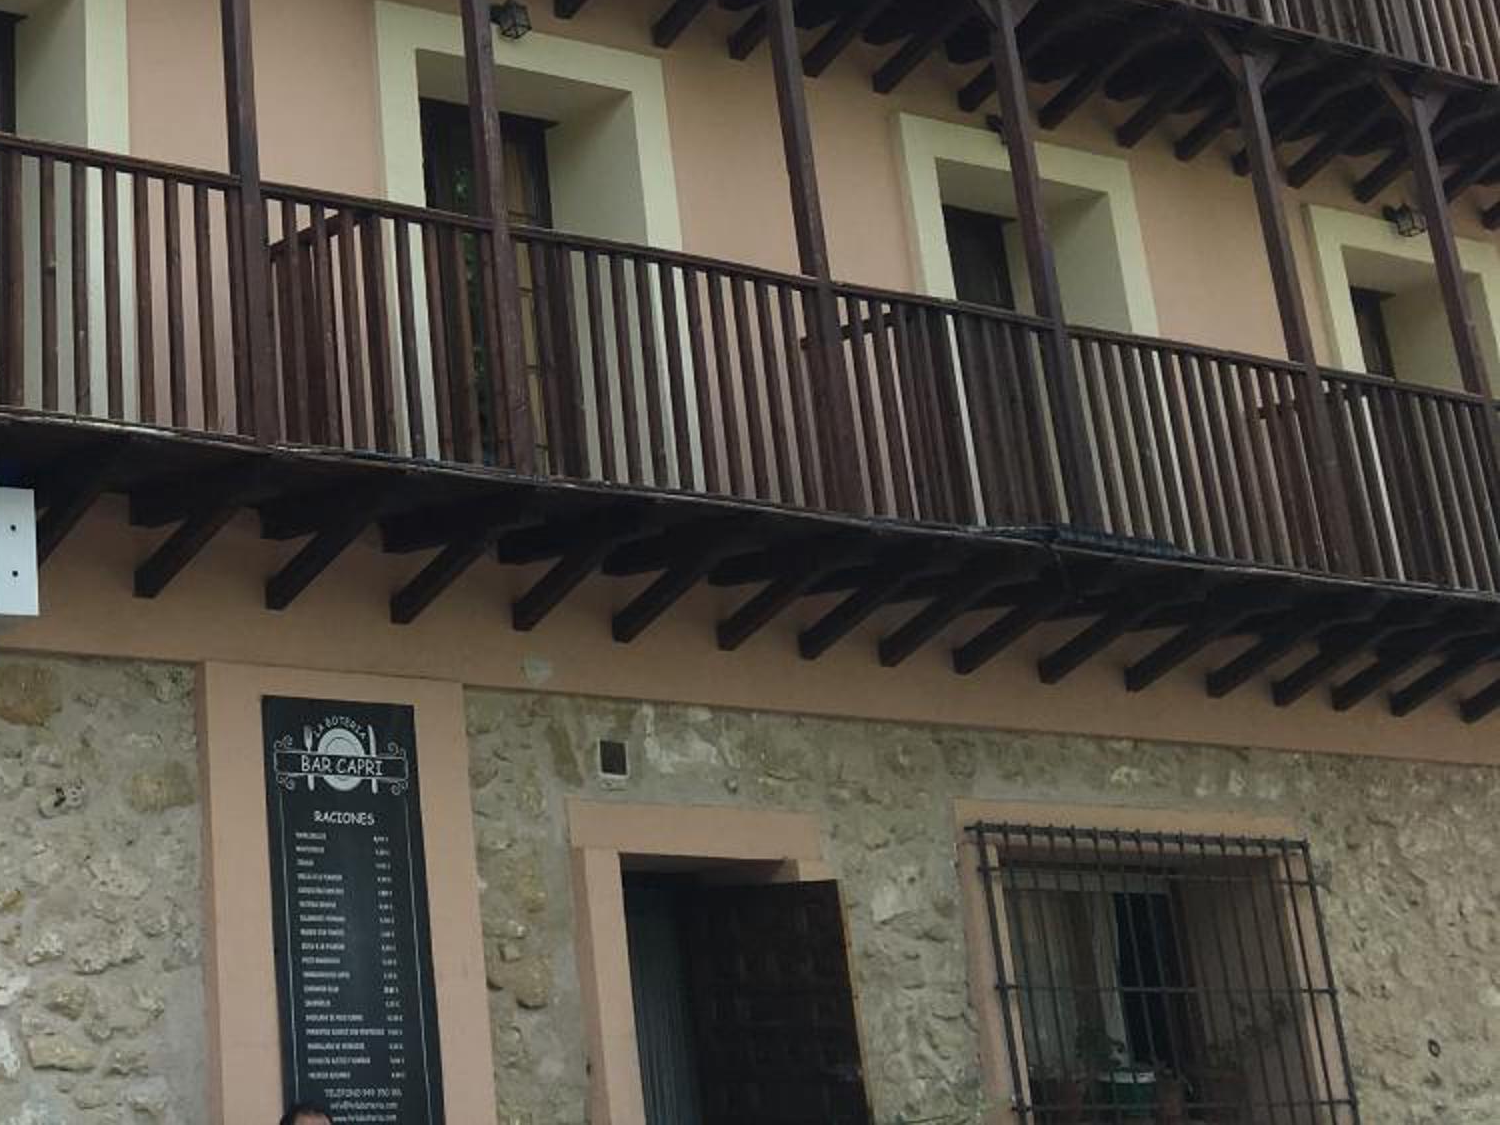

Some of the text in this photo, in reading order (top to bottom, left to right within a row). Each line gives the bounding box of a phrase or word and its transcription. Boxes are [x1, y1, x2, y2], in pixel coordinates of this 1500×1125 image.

[301, 755, 383, 776] BAR CAPRI
[313, 810, 376, 826] RACIONES
